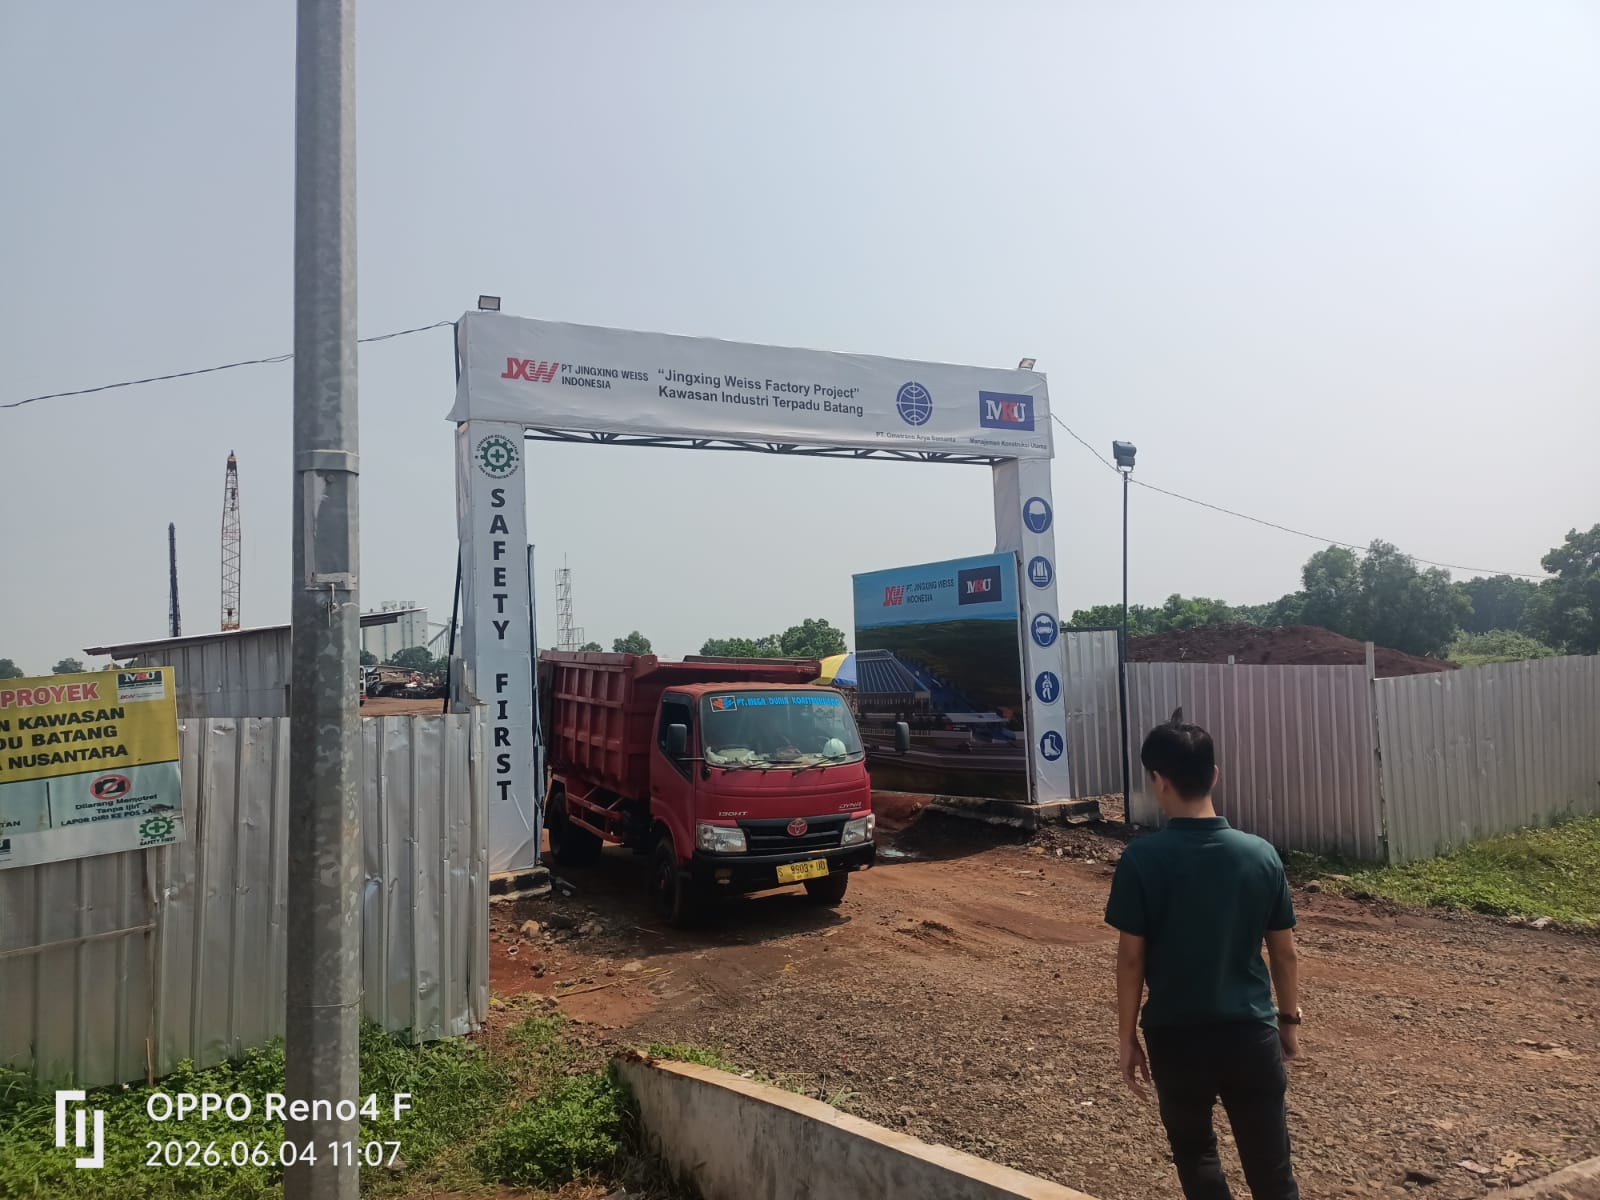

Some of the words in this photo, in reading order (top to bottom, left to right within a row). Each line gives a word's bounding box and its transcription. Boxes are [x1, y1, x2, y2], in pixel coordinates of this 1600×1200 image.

[561, 363, 574, 374] PT
[575, 366, 619, 379] JINGXING
[621, 371, 649, 382] WEISS
[561, 376, 612, 390] INDONESIA
[724, 375, 762, 390] Weiss
[765, 379, 810, 397] Factory
[658, 385, 718, 402] Kawasan
[721, 391, 769, 407] Industri
[772, 395, 820, 411] Terpadu
[823, 400, 863, 418] Batang
[985, 399, 1026, 423] MKU
[489, 488, 510, 641] SAFETY
[0, 682, 99, 708] PROYEK
[18, 707, 125, 730] KAWASAN
[32, 725, 118, 747] BATANG
[493, 672, 512, 801] FIRST
[8, 744, 129, 770] NUSANTARA
[75, 800, 114, 810] Dilarang
[116, 794, 158, 804] Memotret
[96, 806, 124, 814] Tanpa
[61, 817, 90, 826] LAPOR
[91, 814, 110, 822] DIRI
[124, 810, 140, 818] POS
[777, 867, 784, 877] S
